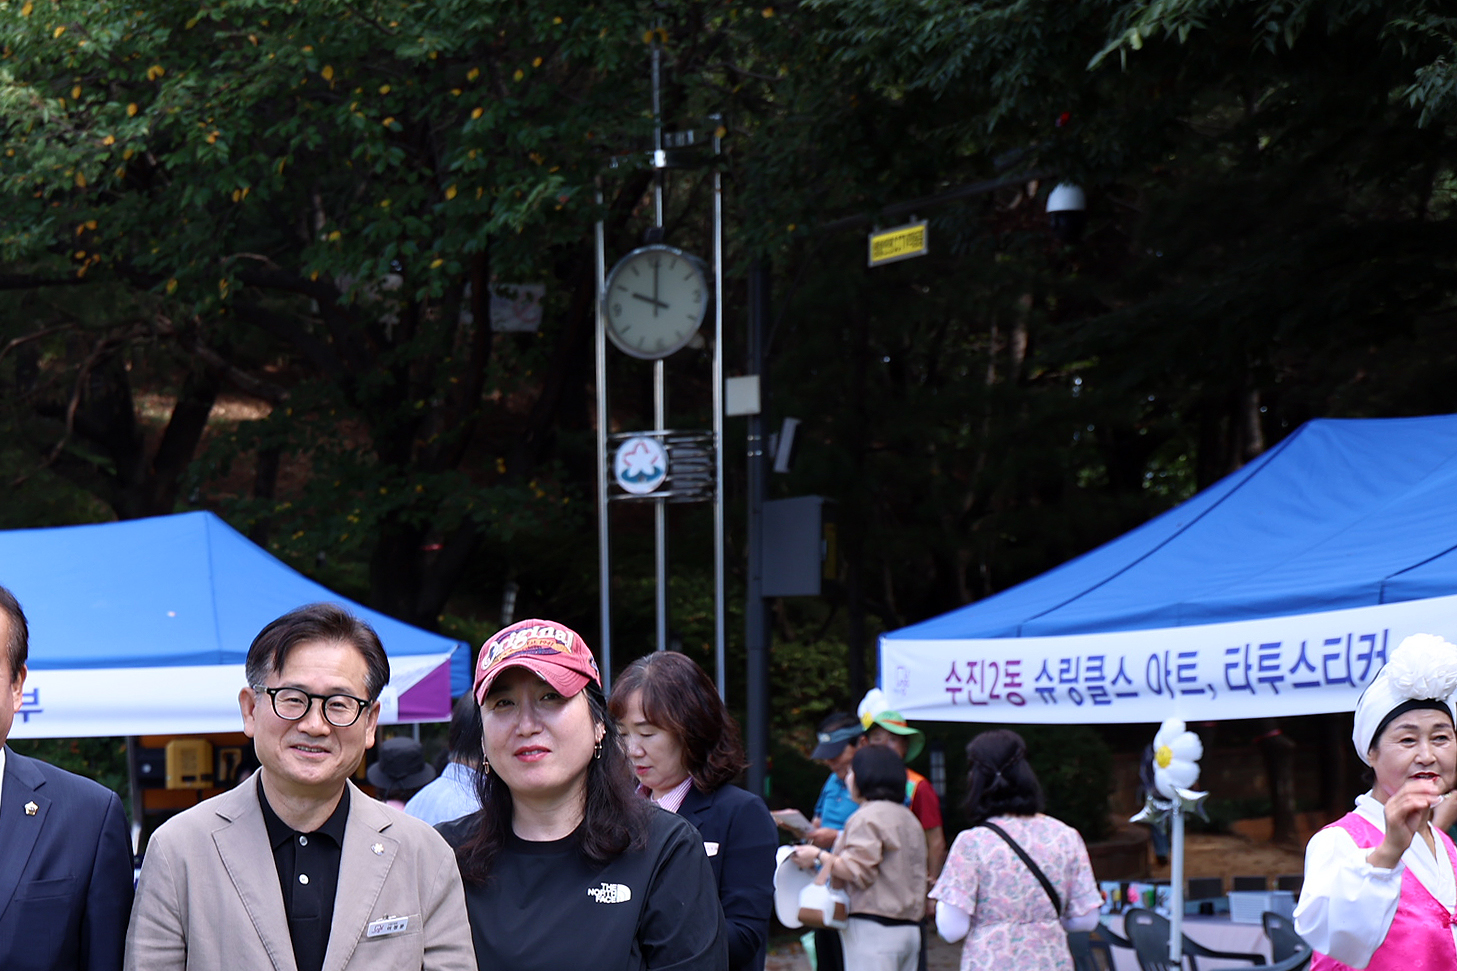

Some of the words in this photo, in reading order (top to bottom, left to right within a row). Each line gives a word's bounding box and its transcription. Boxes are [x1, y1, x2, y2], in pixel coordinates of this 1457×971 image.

[482, 625, 574, 671] Original
[945, 658, 1027, 706] 수진2동
[1034, 655, 1139, 706] 슈링클스
[1146, 650, 1216, 700] 아트,
[1225, 628, 1390, 695] 타투스티커
[587, 888, 617, 898] NORTH
[601, 882, 617, 890] THE
